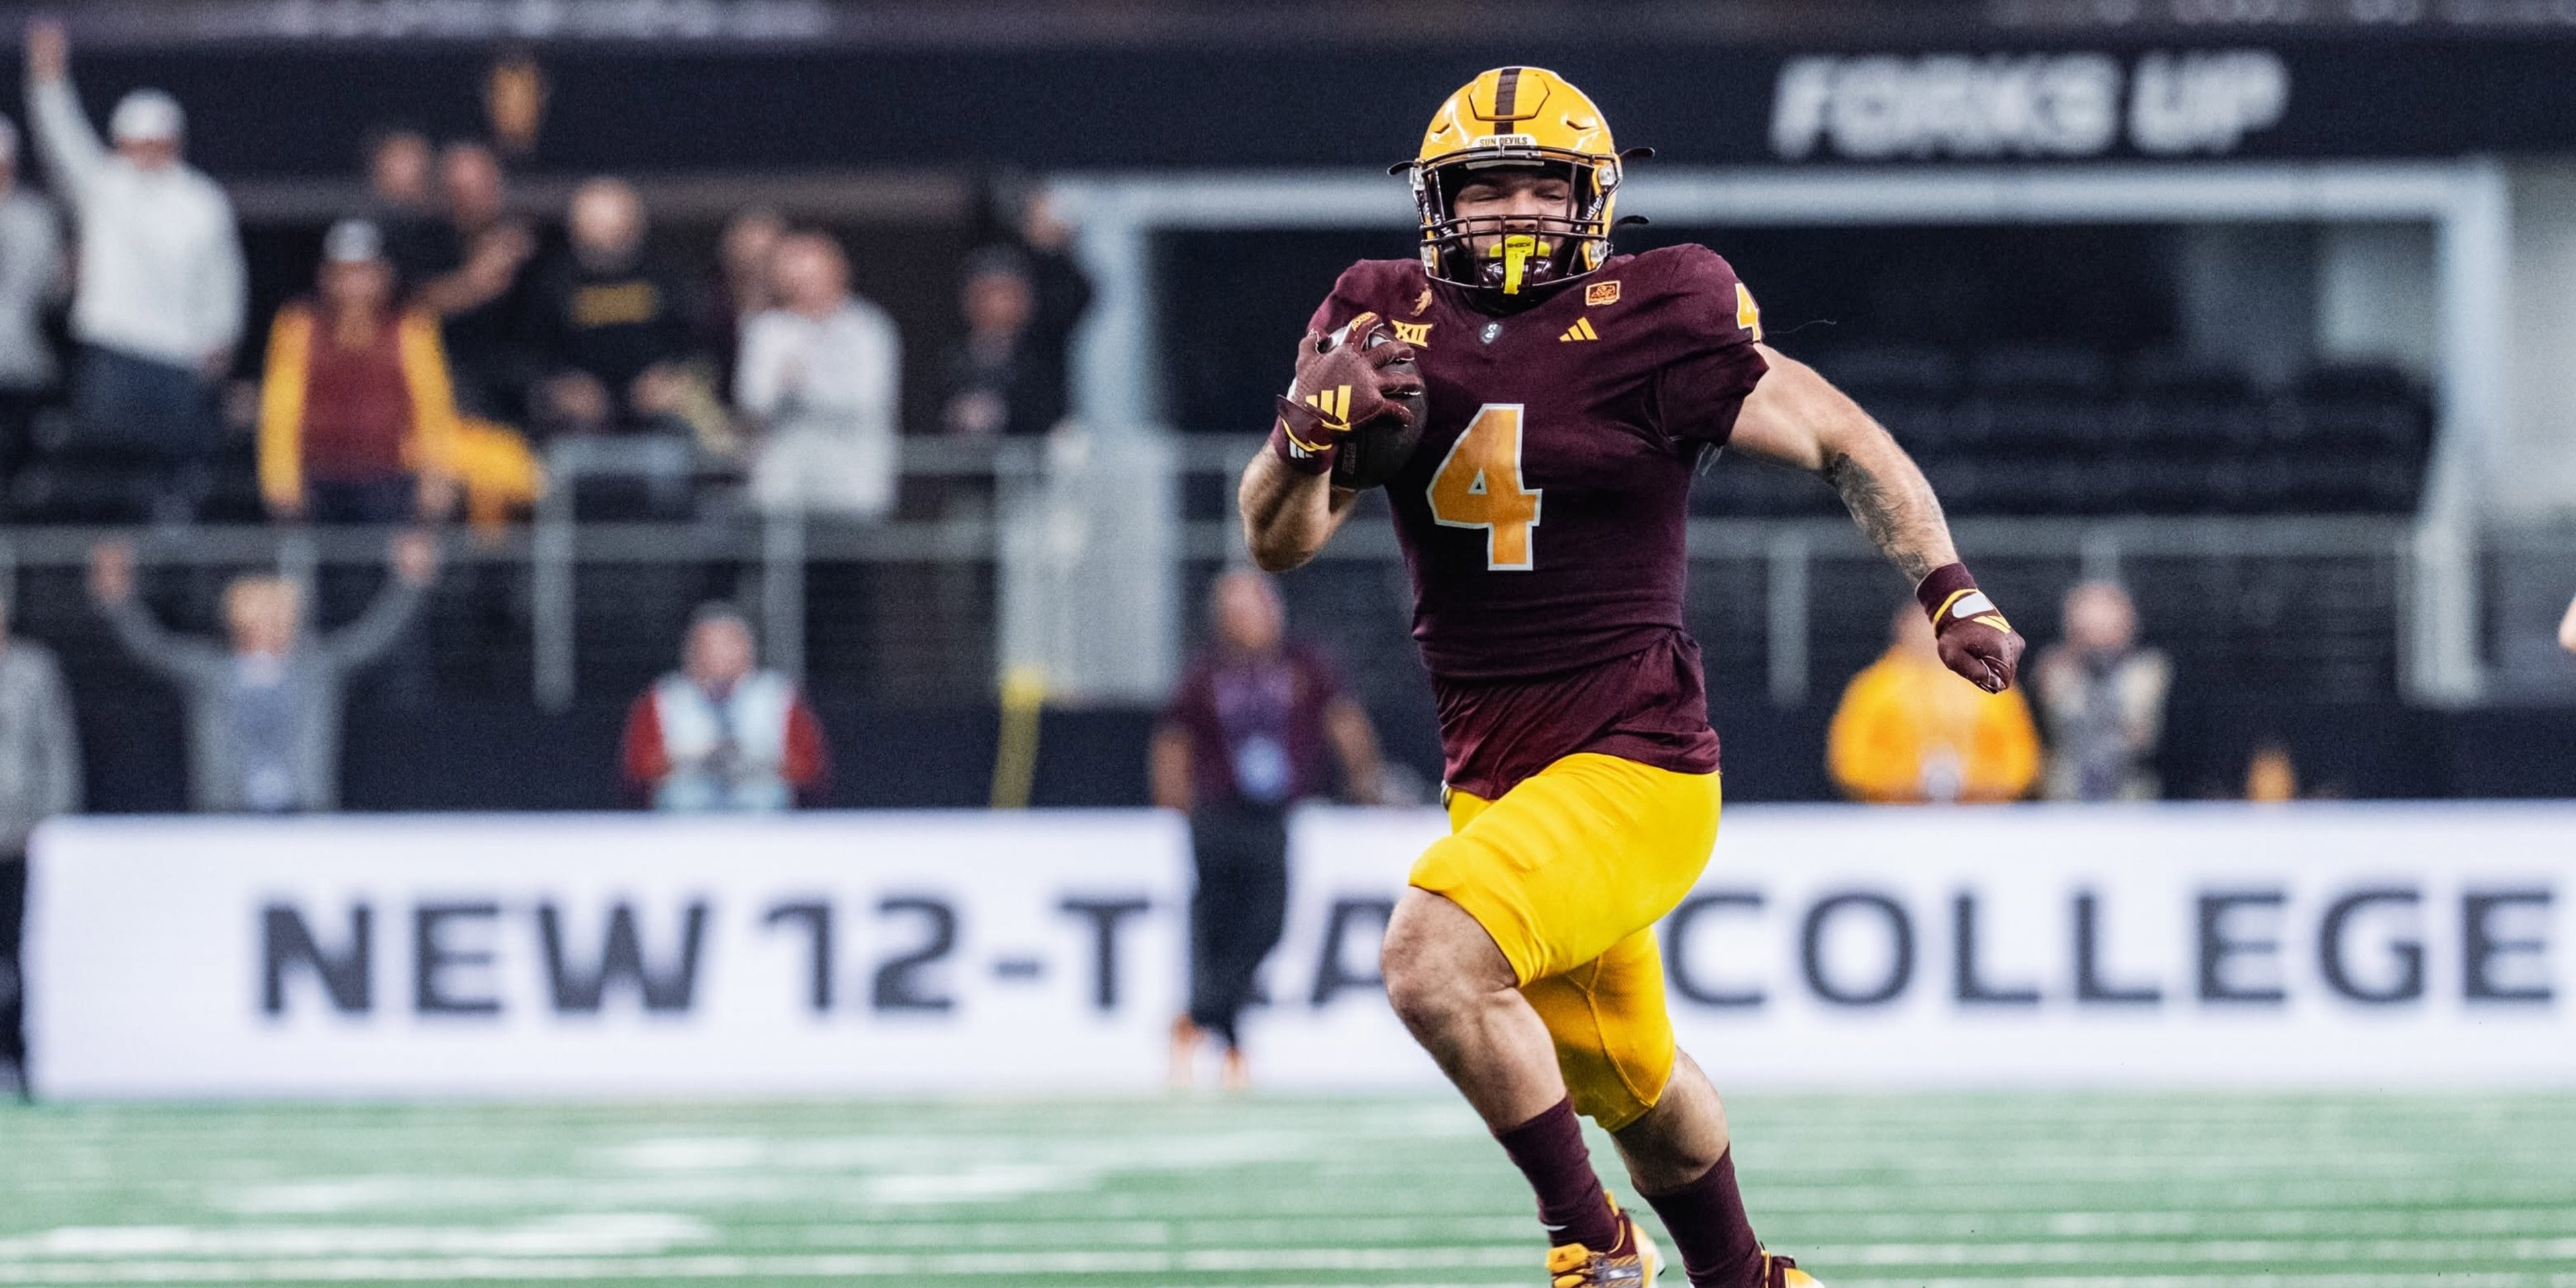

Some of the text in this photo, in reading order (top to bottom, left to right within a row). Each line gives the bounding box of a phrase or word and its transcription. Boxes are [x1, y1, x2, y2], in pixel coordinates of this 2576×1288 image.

[1479, 136, 1528, 147] SUN DEVILS
[2128, 53, 2289, 152] UP
[1391, 319, 1434, 347] XII
[1735, 282, 1762, 341] 4
[1426, 403, 1542, 571] 4
[261, 890, 2555, 1014] NEW 12-TA COLLEGE
